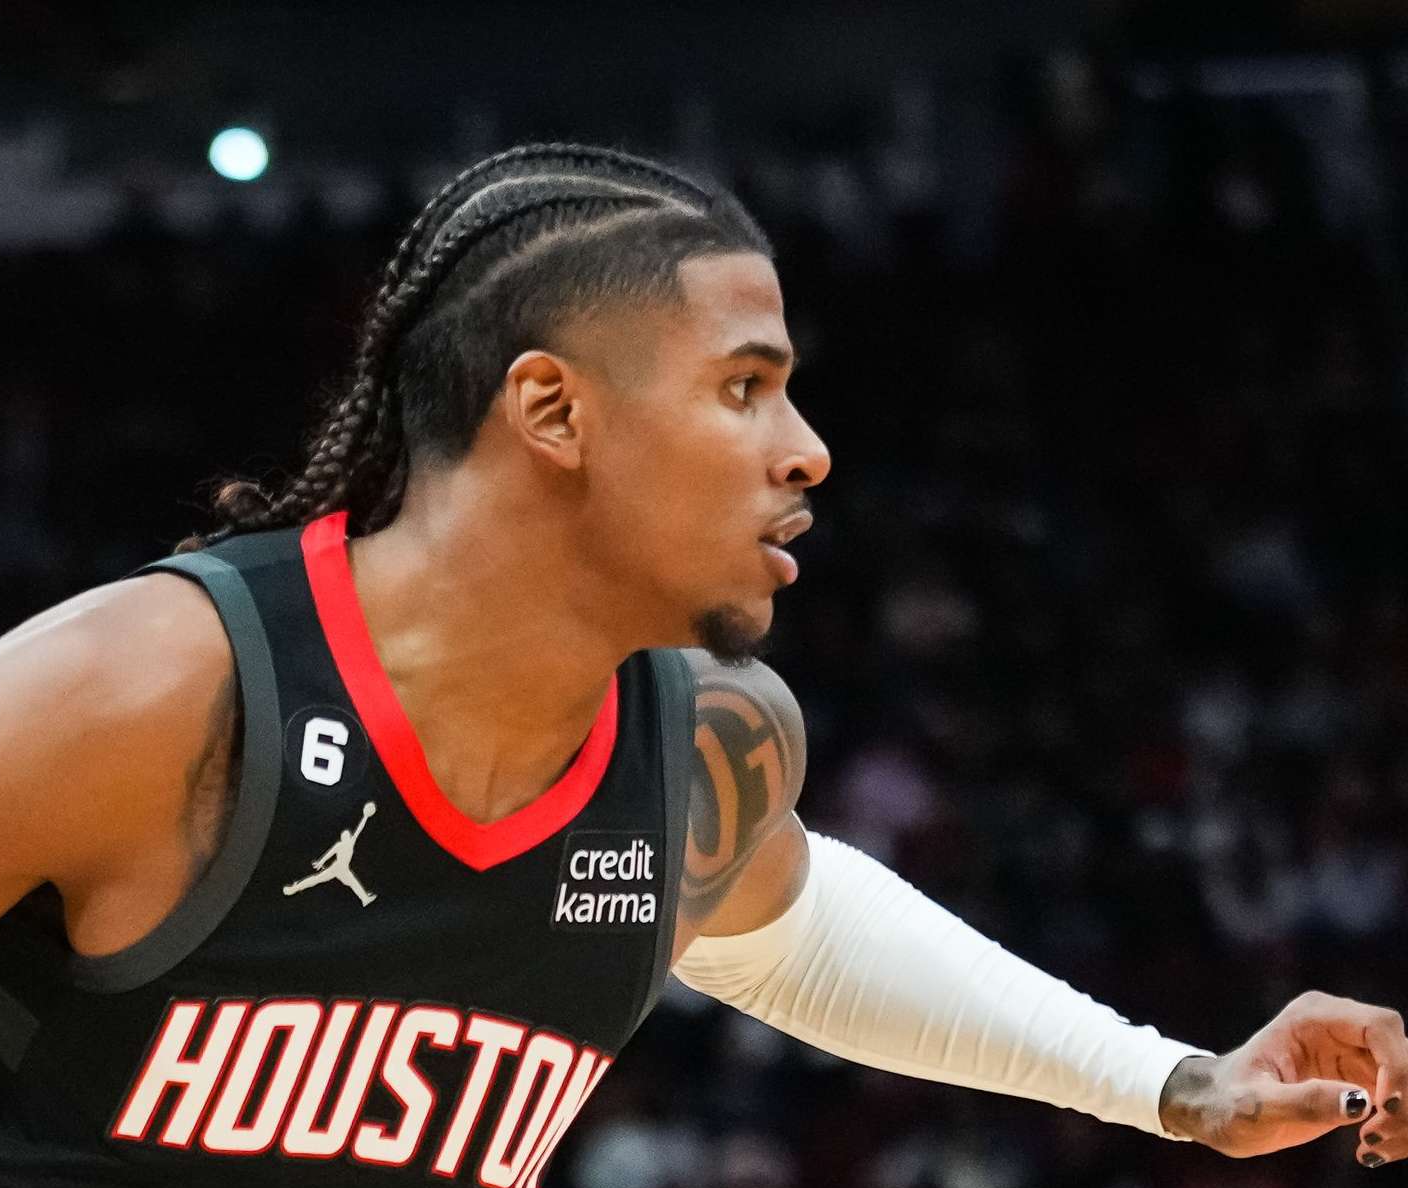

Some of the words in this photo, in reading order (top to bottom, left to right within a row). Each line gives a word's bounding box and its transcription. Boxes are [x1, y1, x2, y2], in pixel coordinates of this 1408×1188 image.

[300, 717, 350, 786] 6
[569, 839, 655, 881] credit
[554, 882, 657, 923] karma
